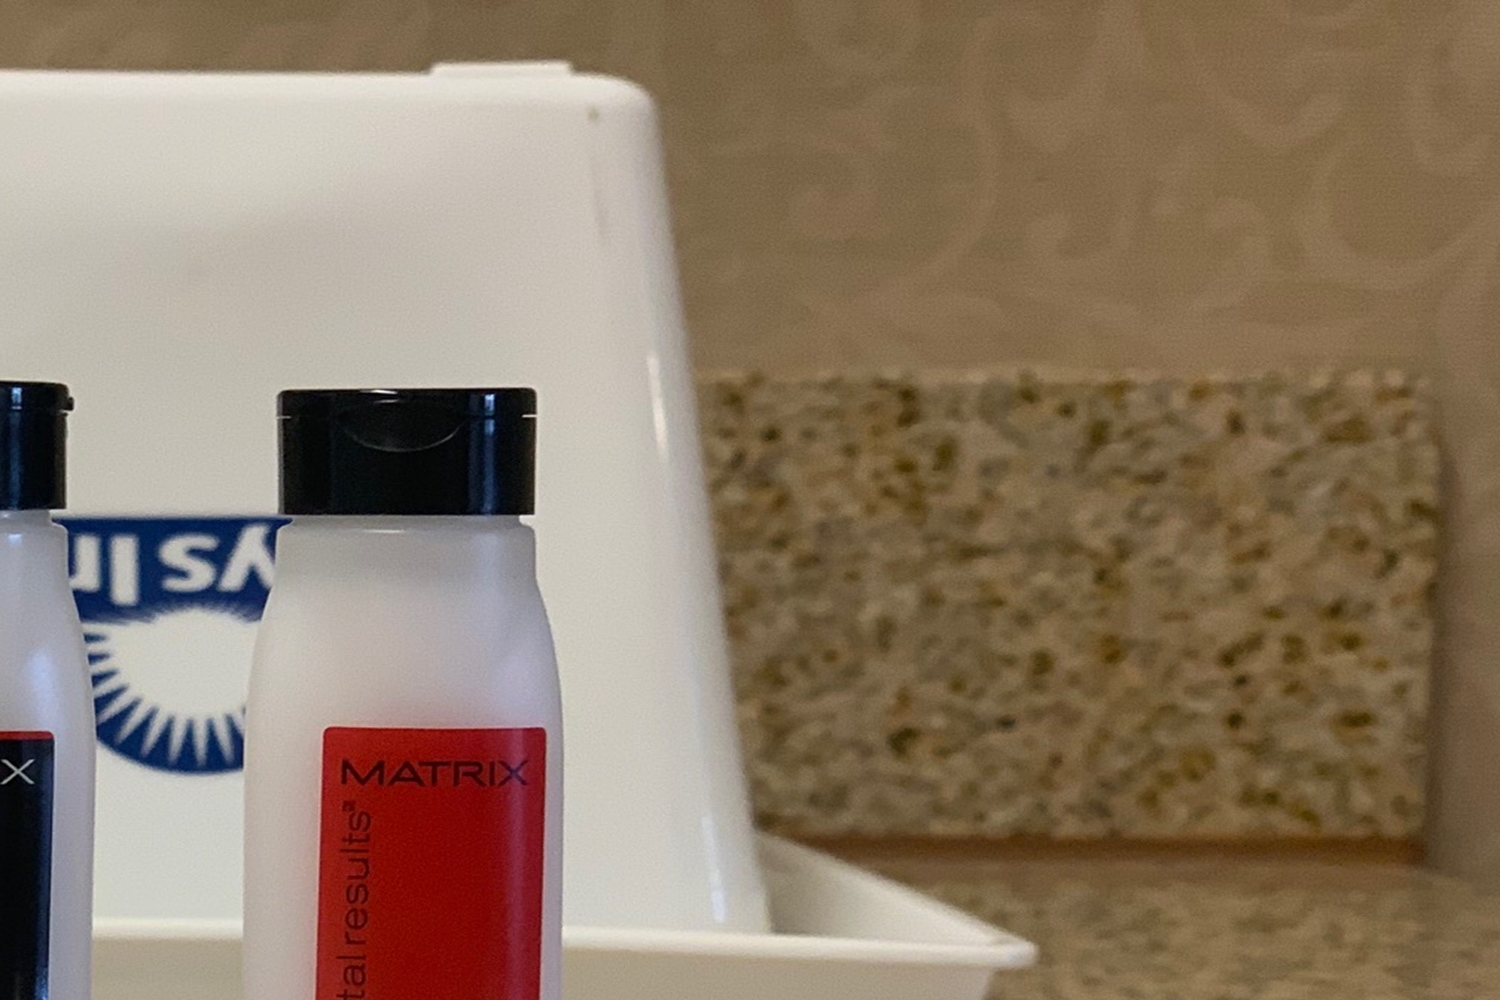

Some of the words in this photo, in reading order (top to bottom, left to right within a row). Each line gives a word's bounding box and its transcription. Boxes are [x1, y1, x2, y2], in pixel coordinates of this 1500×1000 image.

[69, 534, 138, 606] In
[158, 523, 275, 592] ys
[340, 758, 530, 788] MATRIX
